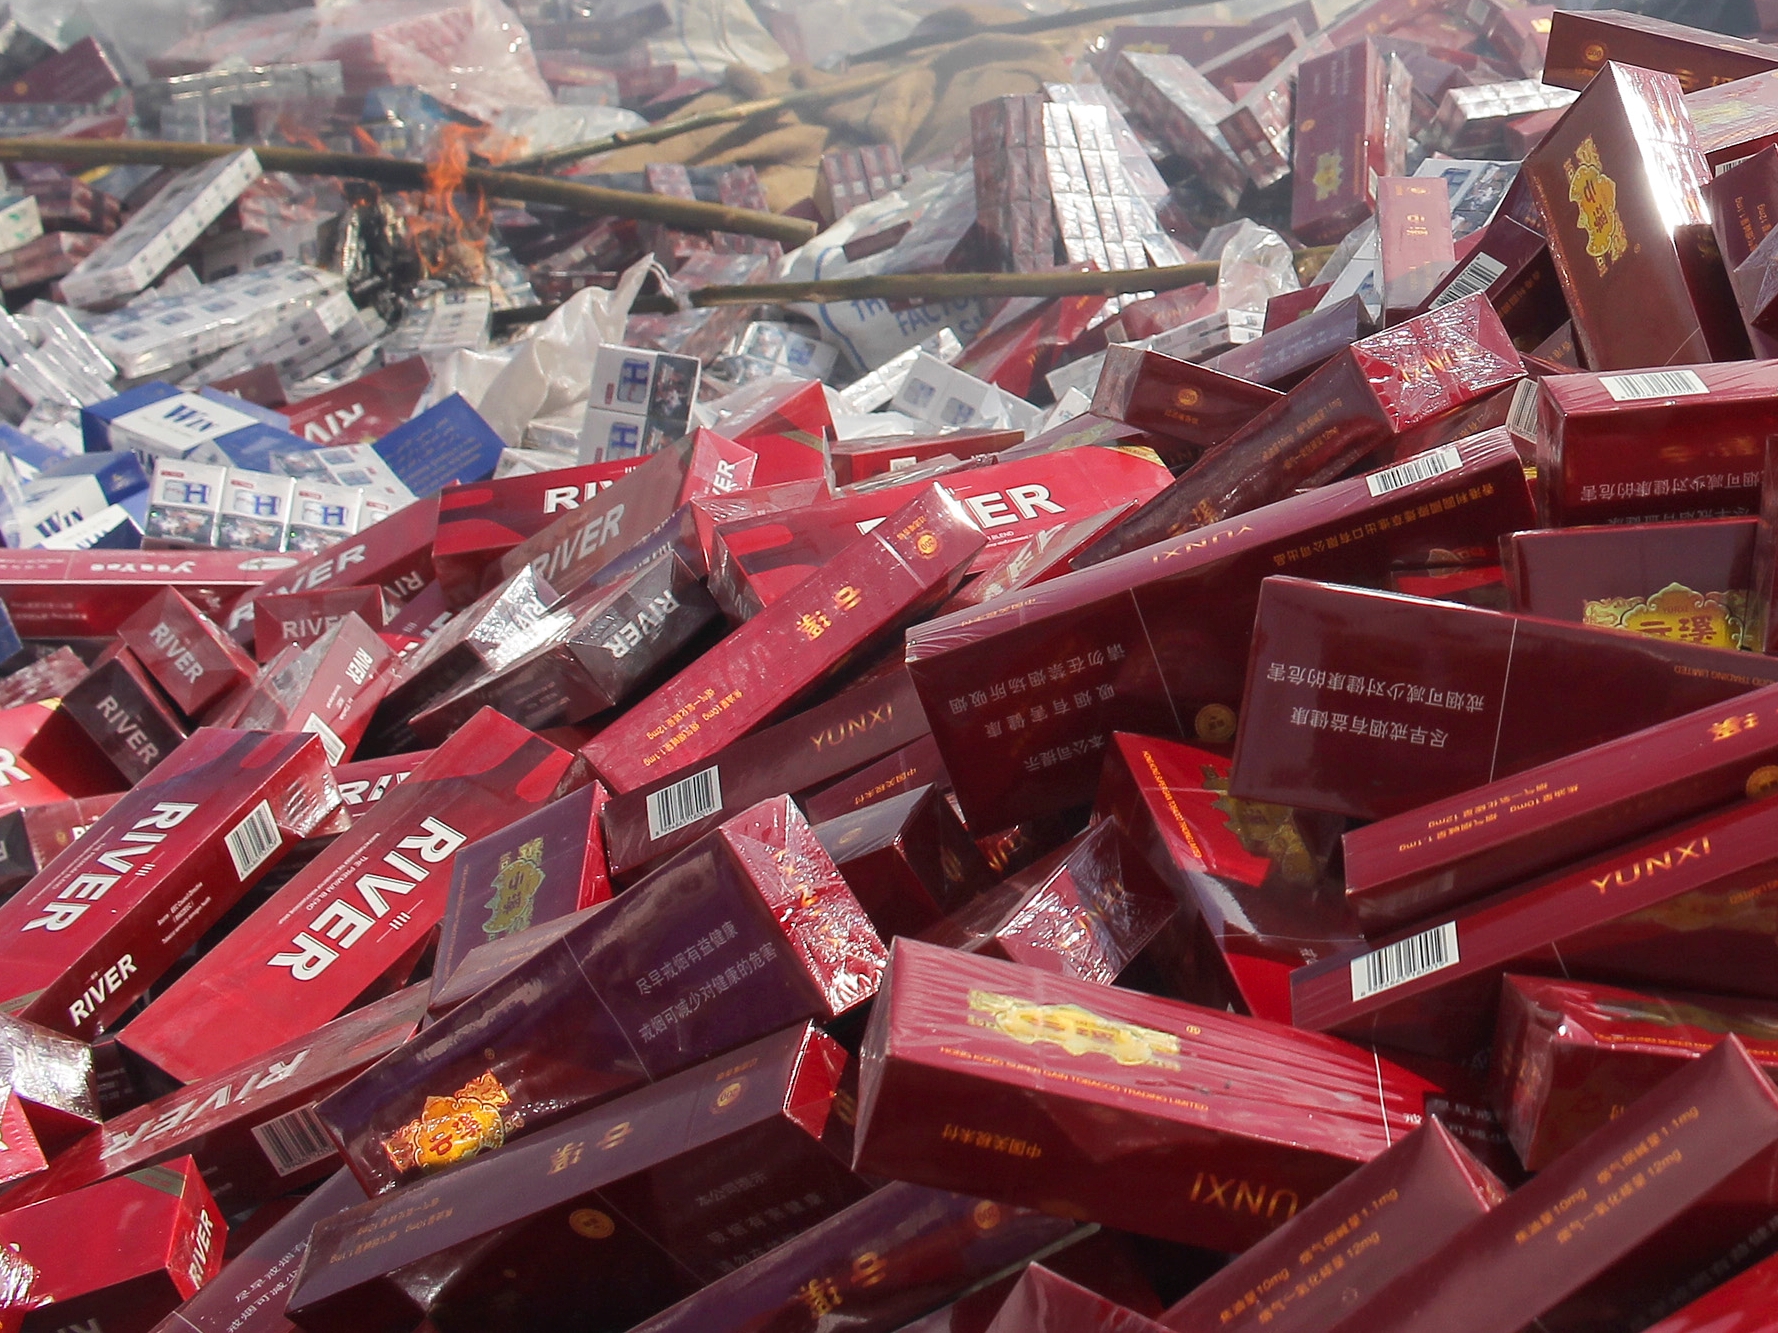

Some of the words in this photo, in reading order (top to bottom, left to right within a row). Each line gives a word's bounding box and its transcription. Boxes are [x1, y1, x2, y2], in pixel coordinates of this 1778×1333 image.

[1150, 523, 1255, 565] YUNXI
[602, 588, 680, 659] RIVER
[796, 585, 862, 641] 云溪
[148, 622, 204, 684] RIVER
[345, 646, 376, 686] RIVER
[948, 642, 1126, 717] 请勿在禁烟场所吸烟
[985, 682, 1117, 741] 吸烟有害健康
[1265, 660, 1486, 714] 戒烟可减少对健康的危害
[96, 694, 160, 765] RIVER
[810, 702, 894, 753] YUNXI
[1022, 733, 1106, 774] 本公司提示
[1289, 705, 1450, 749] 尽早戒烟有益健康
[21, 801, 199, 932] RIVER
[324, 863, 356, 894] PREMIUM
[352, 853, 368, 868] THE
[1590, 835, 1712, 897] YUNXI
[267, 816, 468, 982] RIVER
[304, 889, 328, 912] BLEND
[635, 920, 739, 997] 尽早戒烟有益健康
[68, 952, 139, 1028] RIVER
[637, 941, 778, 1044] 戒烟可减少对健康的危害
[100, 1048, 311, 1162] RIVER
[188, 1208, 215, 1288] RIVER
